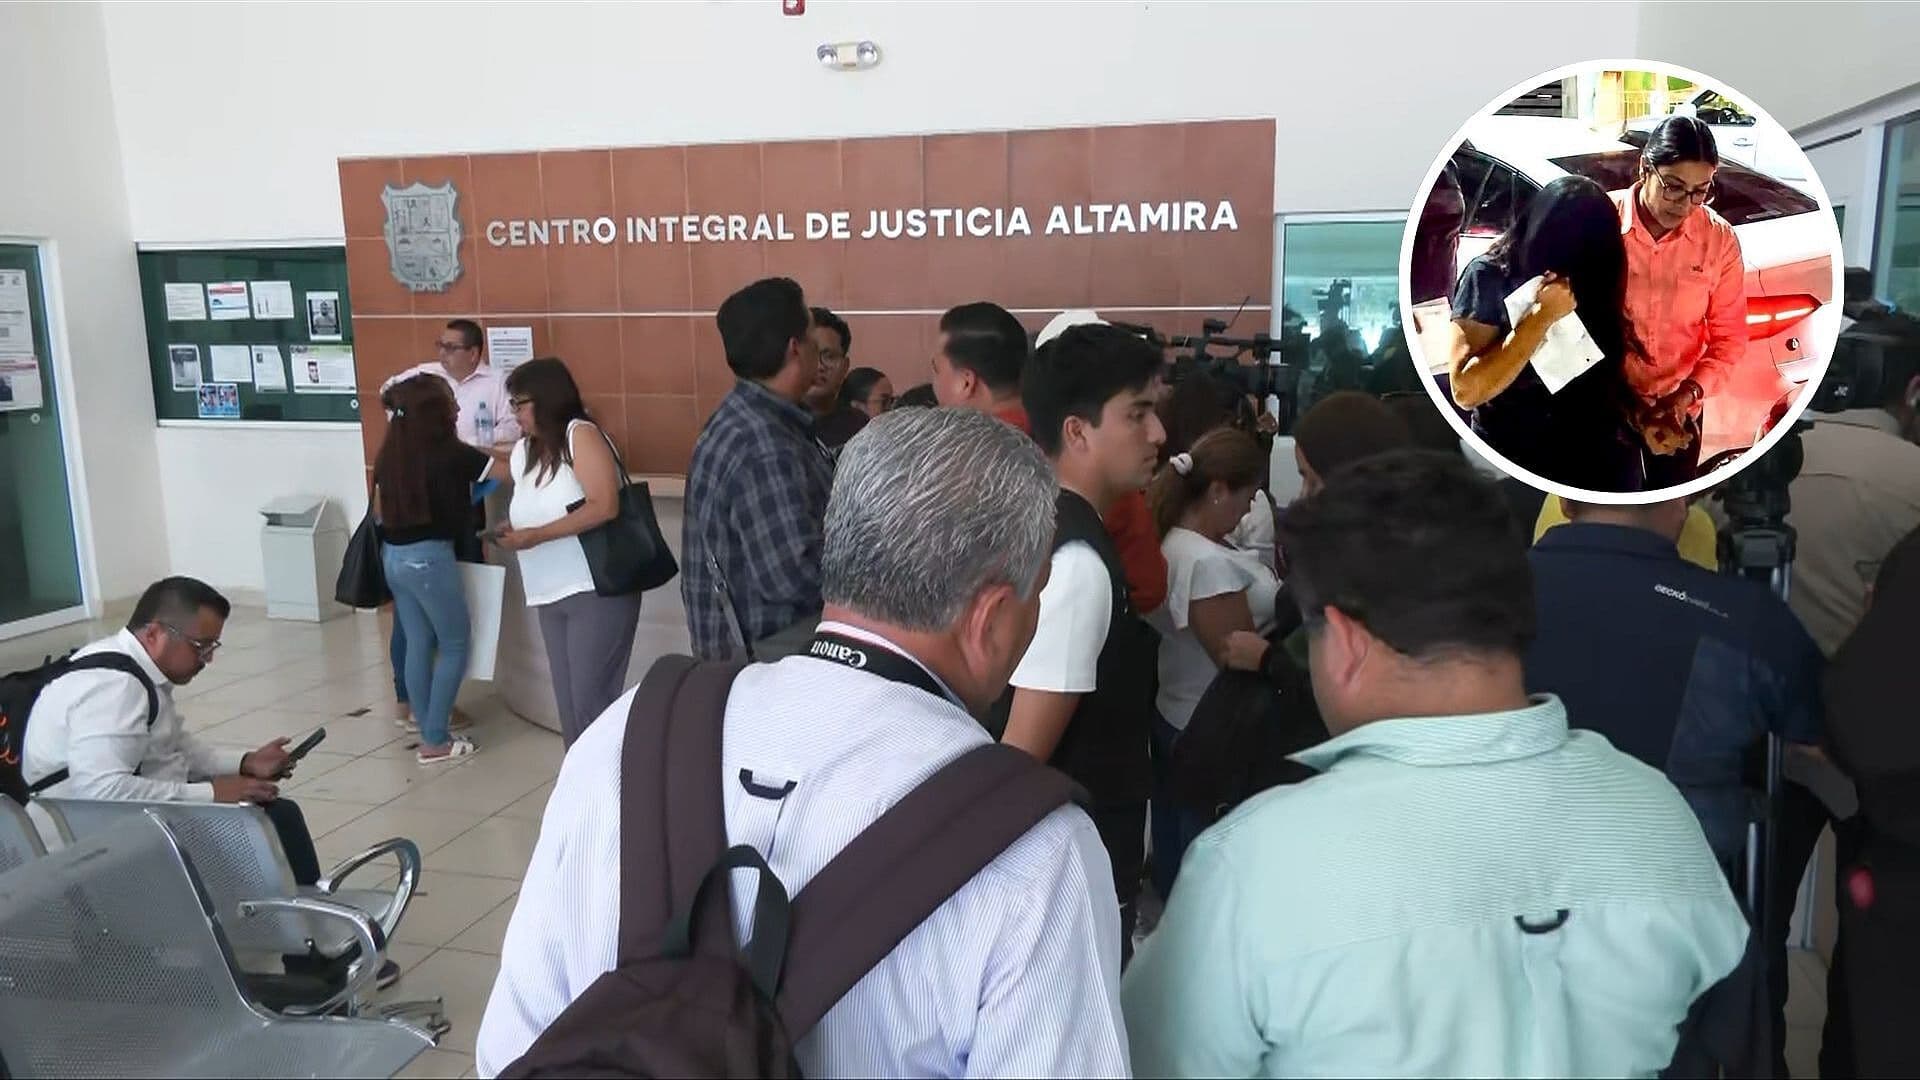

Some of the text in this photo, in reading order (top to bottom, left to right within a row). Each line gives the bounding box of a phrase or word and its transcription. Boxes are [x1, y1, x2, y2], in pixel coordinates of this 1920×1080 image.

[486, 200, 1239, 248] CENTRO INTEGRAL DE JUSTICIA ALTAMIRA
[811, 641, 867, 669] Canon
